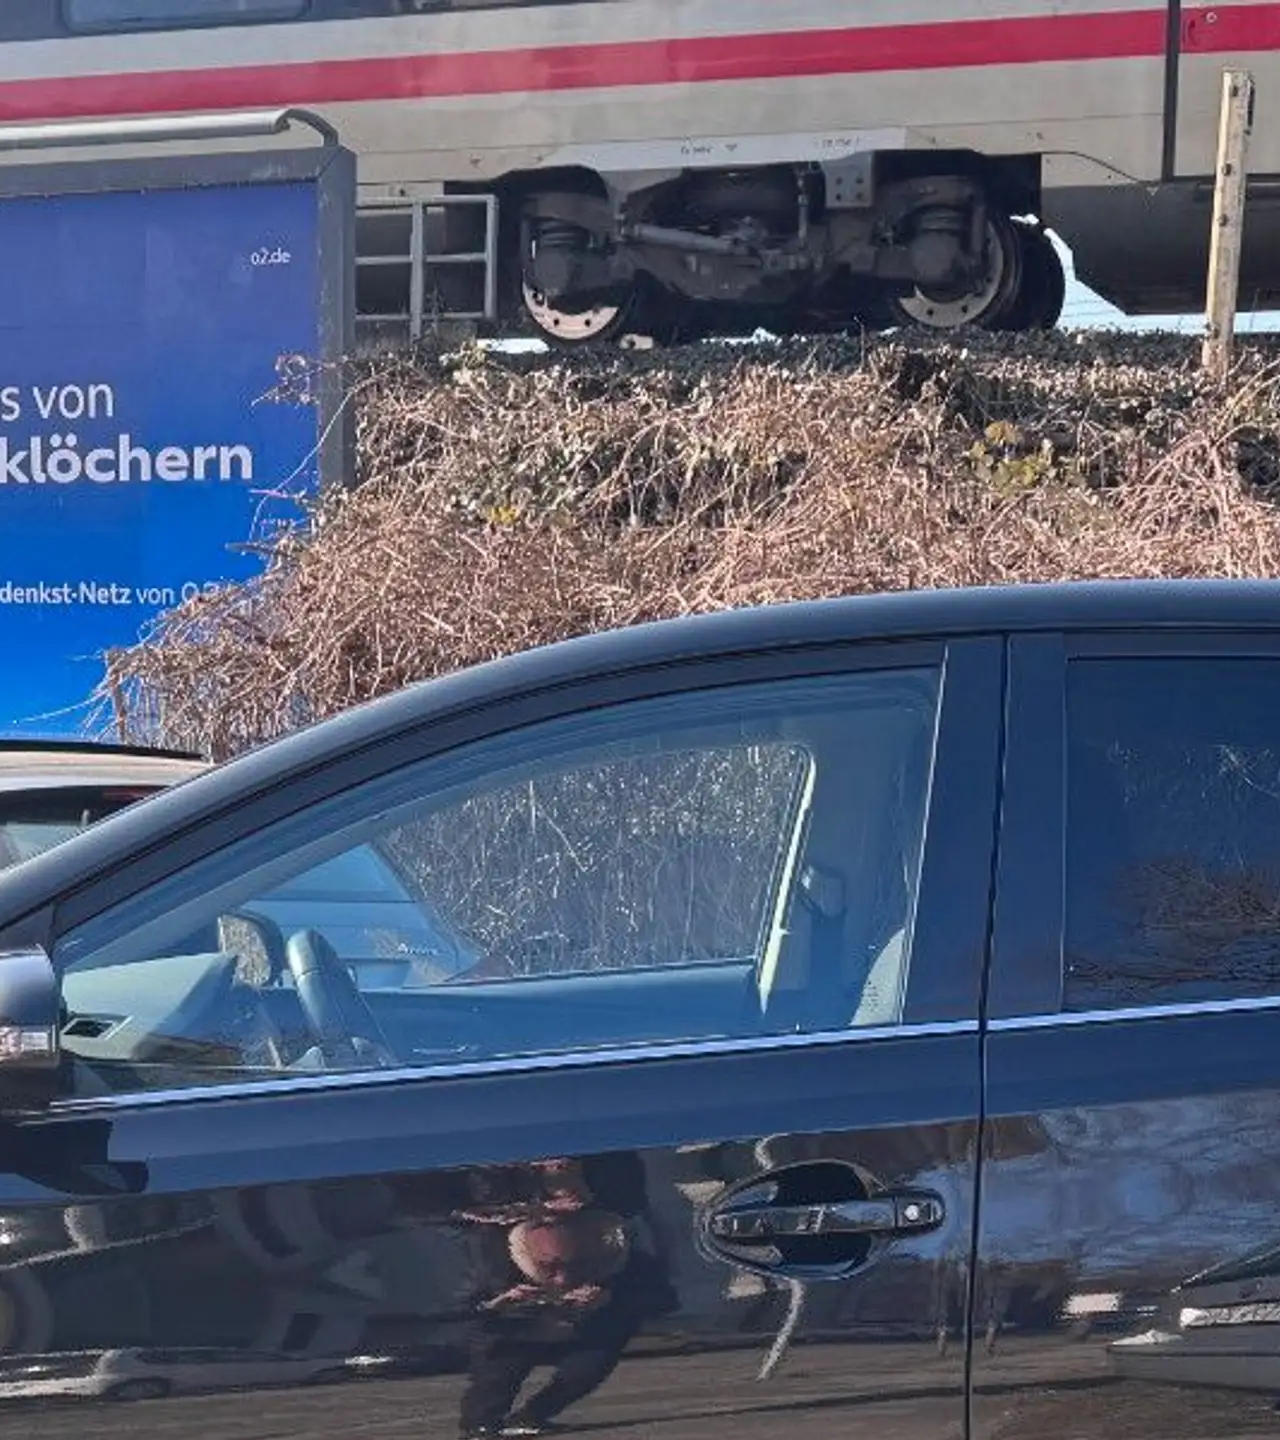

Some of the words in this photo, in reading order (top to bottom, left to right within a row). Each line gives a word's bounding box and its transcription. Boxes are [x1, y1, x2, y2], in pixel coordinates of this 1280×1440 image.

[251, 247, 291, 265] o2.de
[33, 383, 114, 419] von
[136, 586, 176, 603] von
